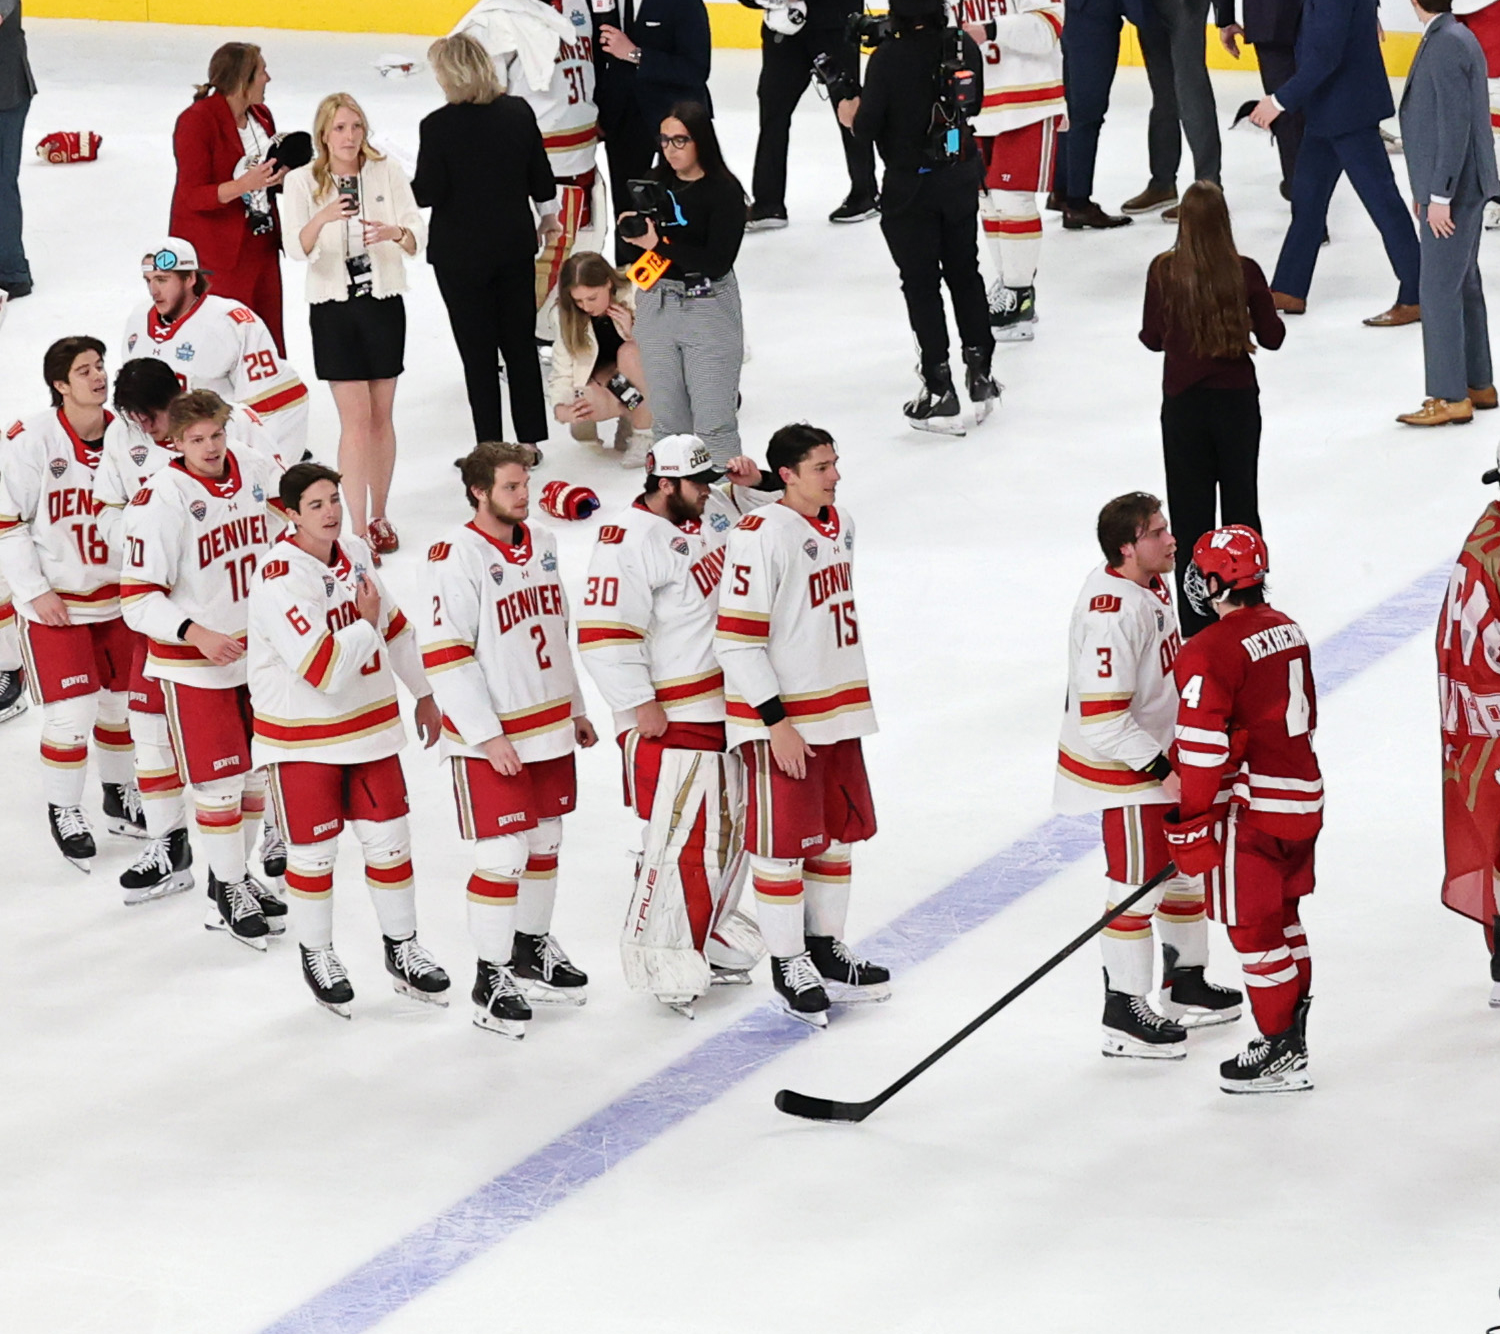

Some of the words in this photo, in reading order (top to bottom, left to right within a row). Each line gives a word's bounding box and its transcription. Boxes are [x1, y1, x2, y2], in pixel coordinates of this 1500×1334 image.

[562, 66, 587, 105] 31
[244, 349, 279, 383] 29
[72, 523, 109, 566] 18
[224, 561, 254, 604] 10
[584, 576, 619, 607] 30
[285, 604, 312, 637] 6
[432, 594, 442, 627] 2
[495, 583, 565, 636] DENVER
[829, 600, 859, 648] 15
[530, 624, 552, 671] 2
[1096, 647, 1112, 679] 3
[61, 673, 90, 689] DENVER
[1181, 674, 1204, 709] 4
[212, 754, 241, 771] DENVER
[313, 818, 340, 836] DENVER
[497, 811, 528, 827] DENVER
[633, 867, 658, 938] TRUE
